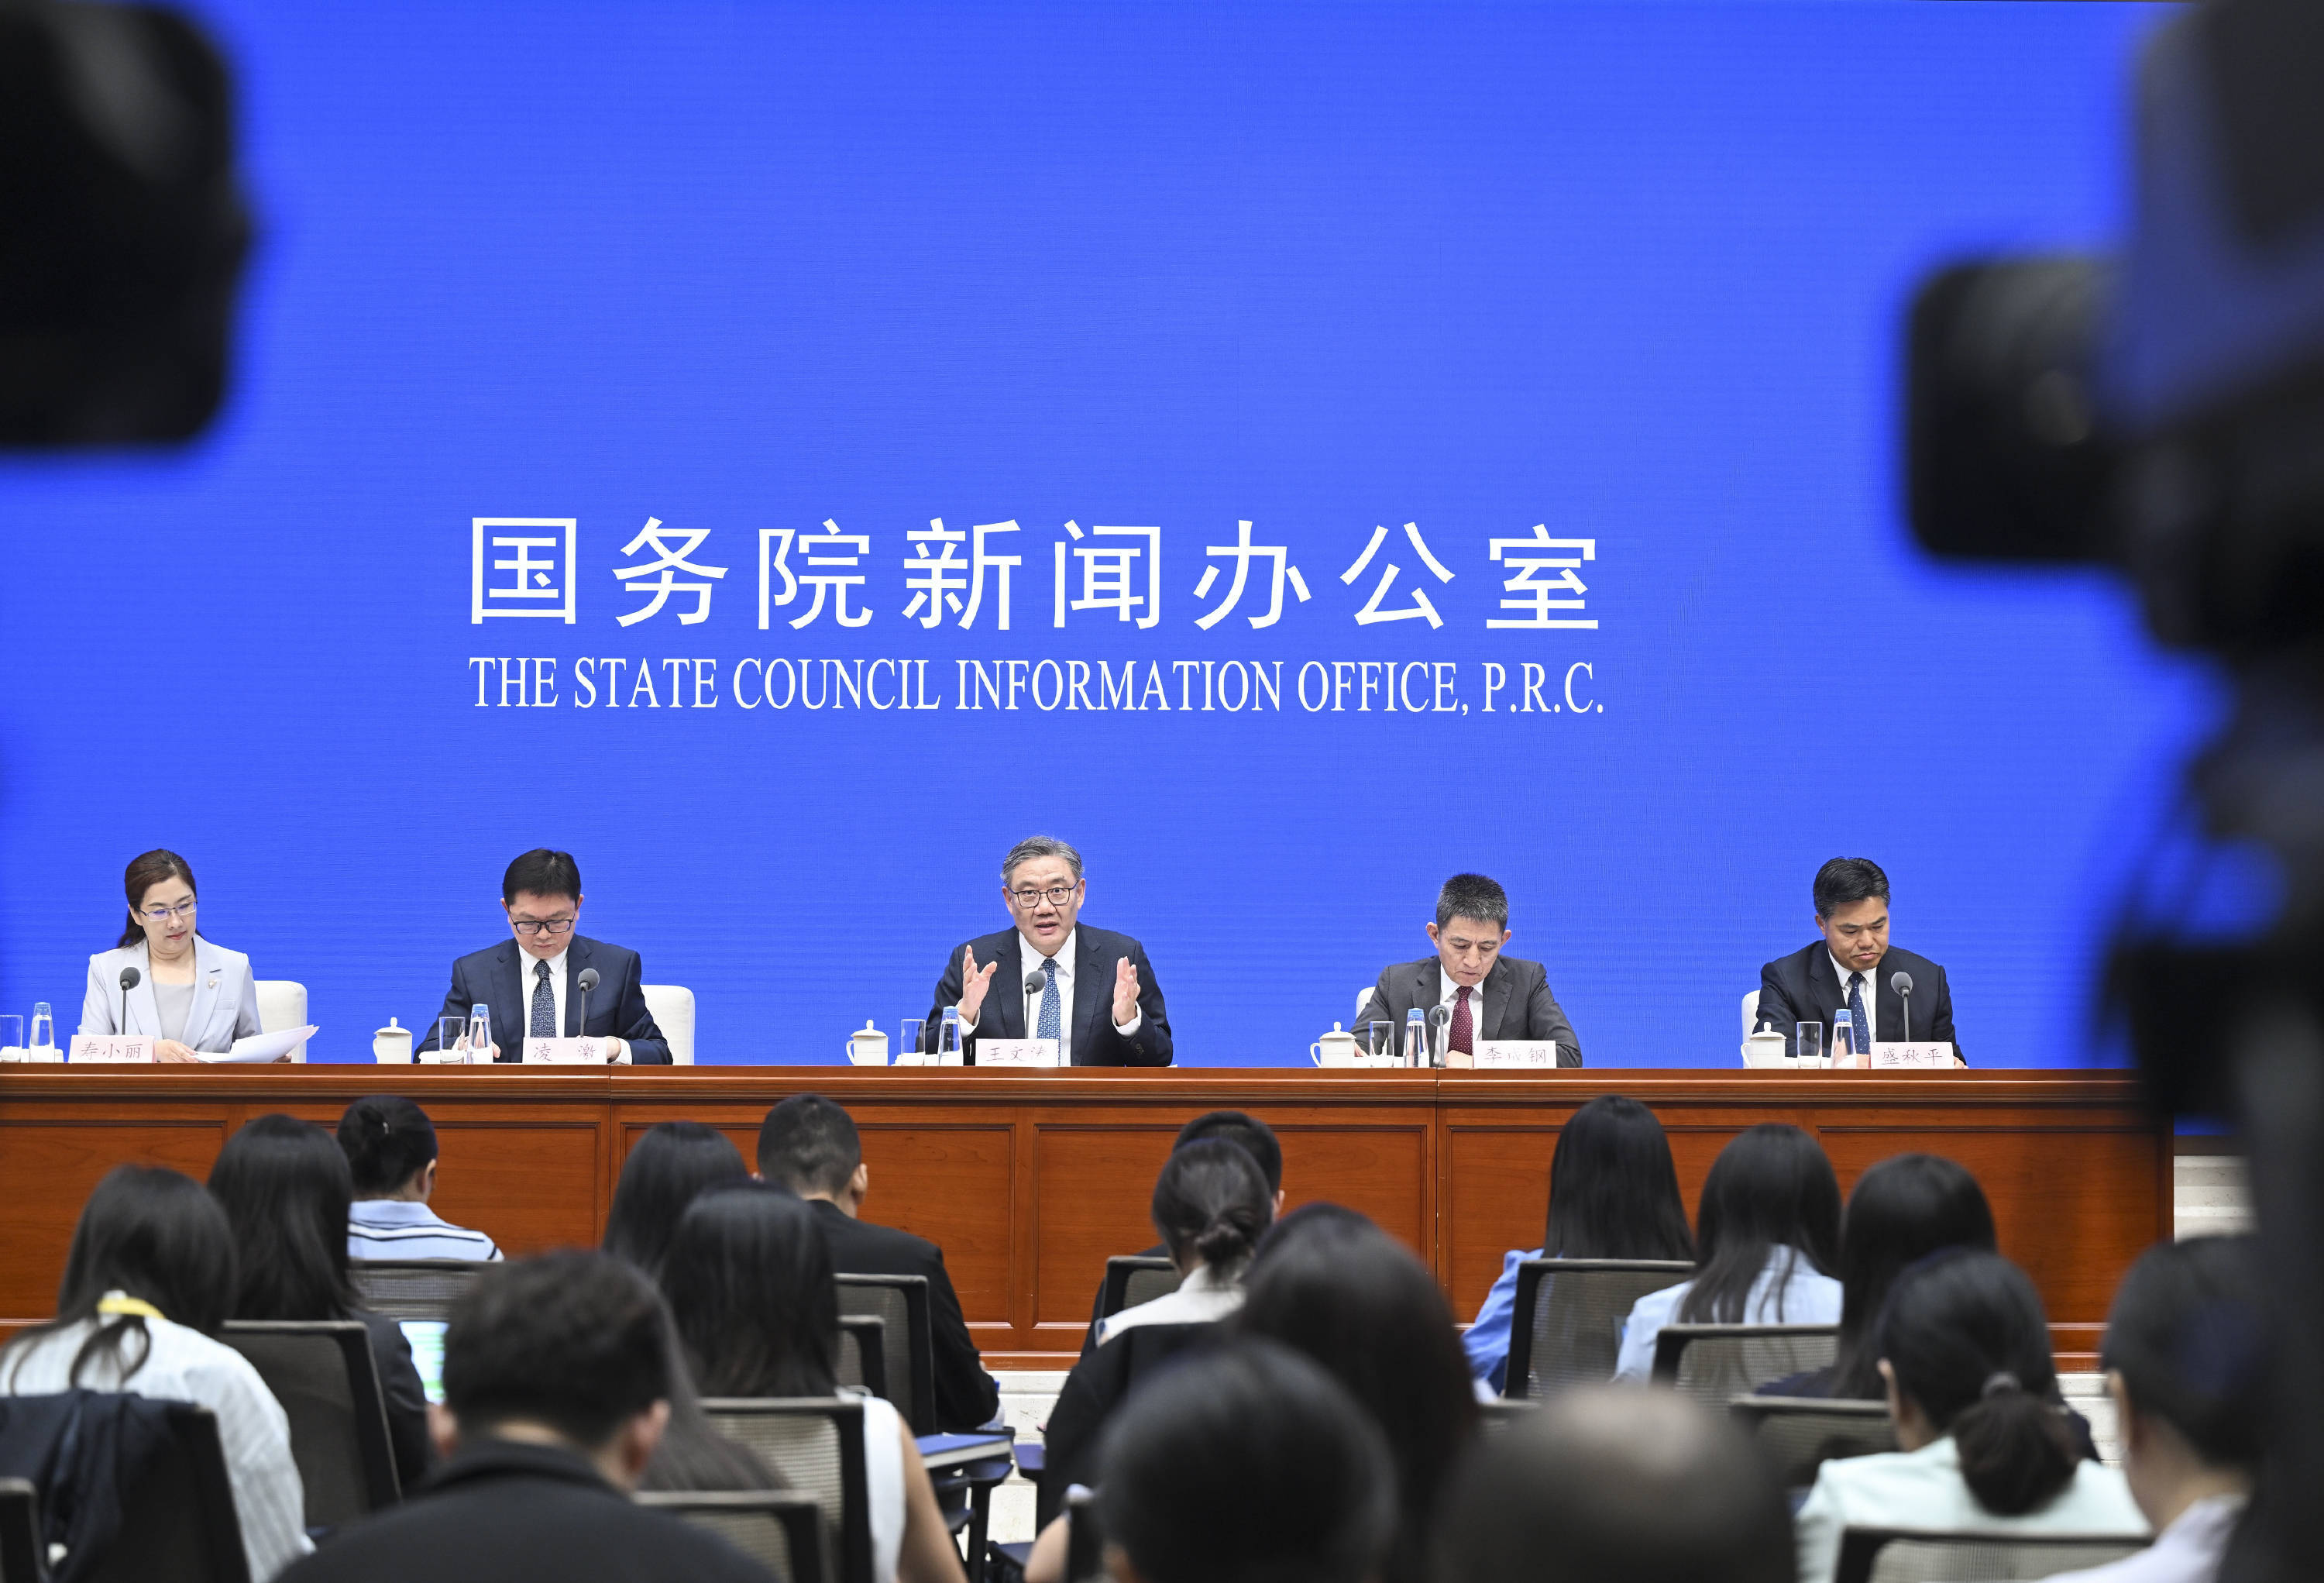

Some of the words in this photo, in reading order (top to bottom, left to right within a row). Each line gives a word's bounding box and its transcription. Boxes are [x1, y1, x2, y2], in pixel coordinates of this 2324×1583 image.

[470, 516, 1600, 631] 国务院新闻办公室
[469, 657, 559, 707] THE
[574, 656, 719, 709] STATE
[733, 657, 941, 710] COUNCIL
[955, 659, 1284, 712] INFORMATION
[1298, 660, 1469, 716] OFFICE,
[1481, 662, 1604, 714] P.R.C.
[80, 1041, 143, 1061] 寿小丽
[1881, 1048, 1943, 1066] 盛秋平
